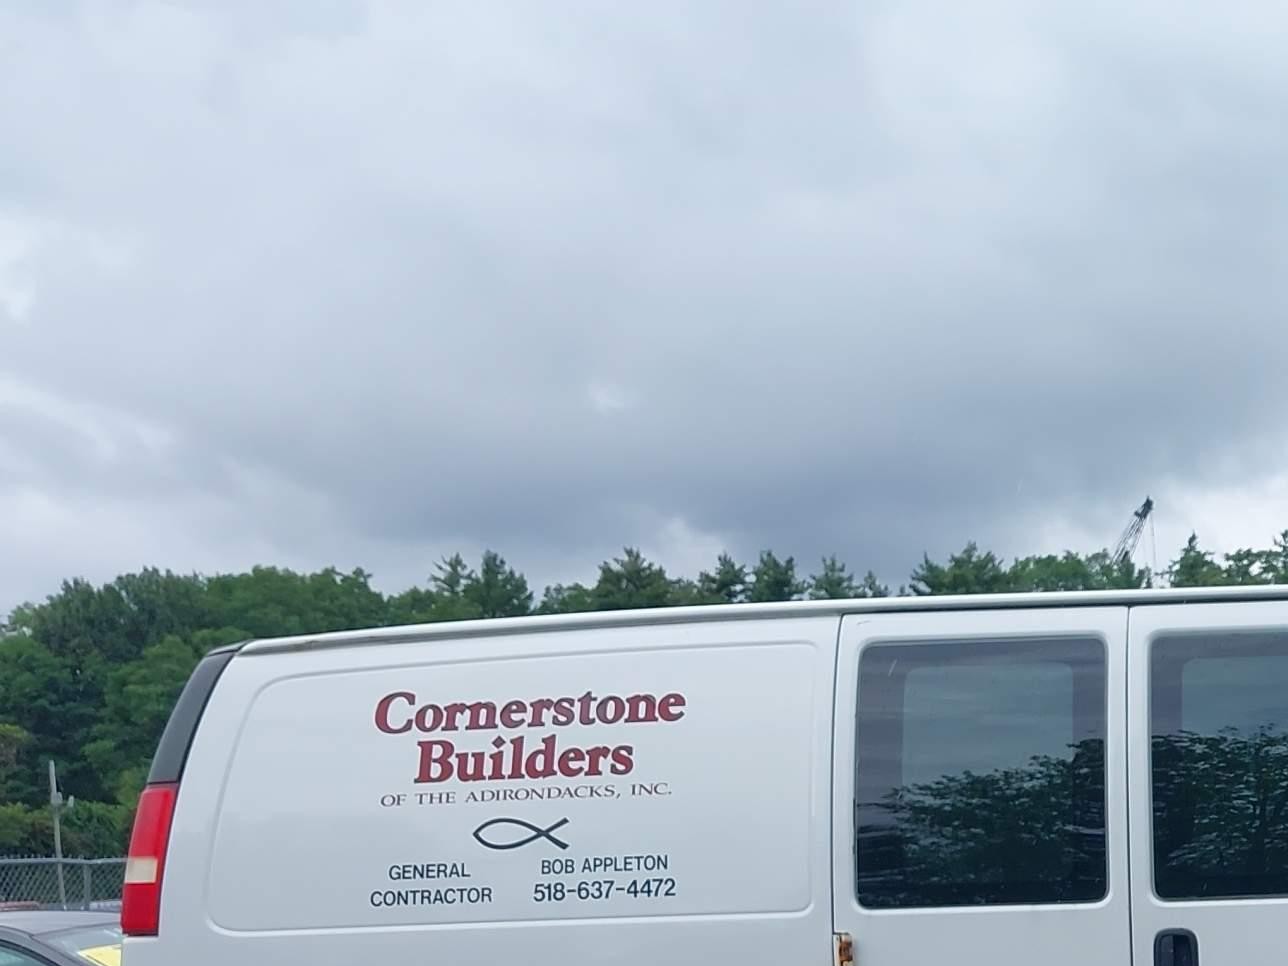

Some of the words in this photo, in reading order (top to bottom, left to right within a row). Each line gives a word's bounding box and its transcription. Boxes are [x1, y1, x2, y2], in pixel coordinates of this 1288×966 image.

[375, 691, 687, 734] Cornerstone
[413, 734, 634, 784] Builders
[380, 793, 406, 808] OF
[414, 791, 456, 805] THE
[465, 784, 621, 803] ADIRONDACKS,
[631, 783, 672, 797] INC.
[388, 863, 471, 881] GENERAL
[541, 859, 575, 875] BOB
[581, 855, 669, 873] APPLETON
[370, 888, 493, 907] CONTRACTOR
[533, 878, 676, 902] 518-637-4472
